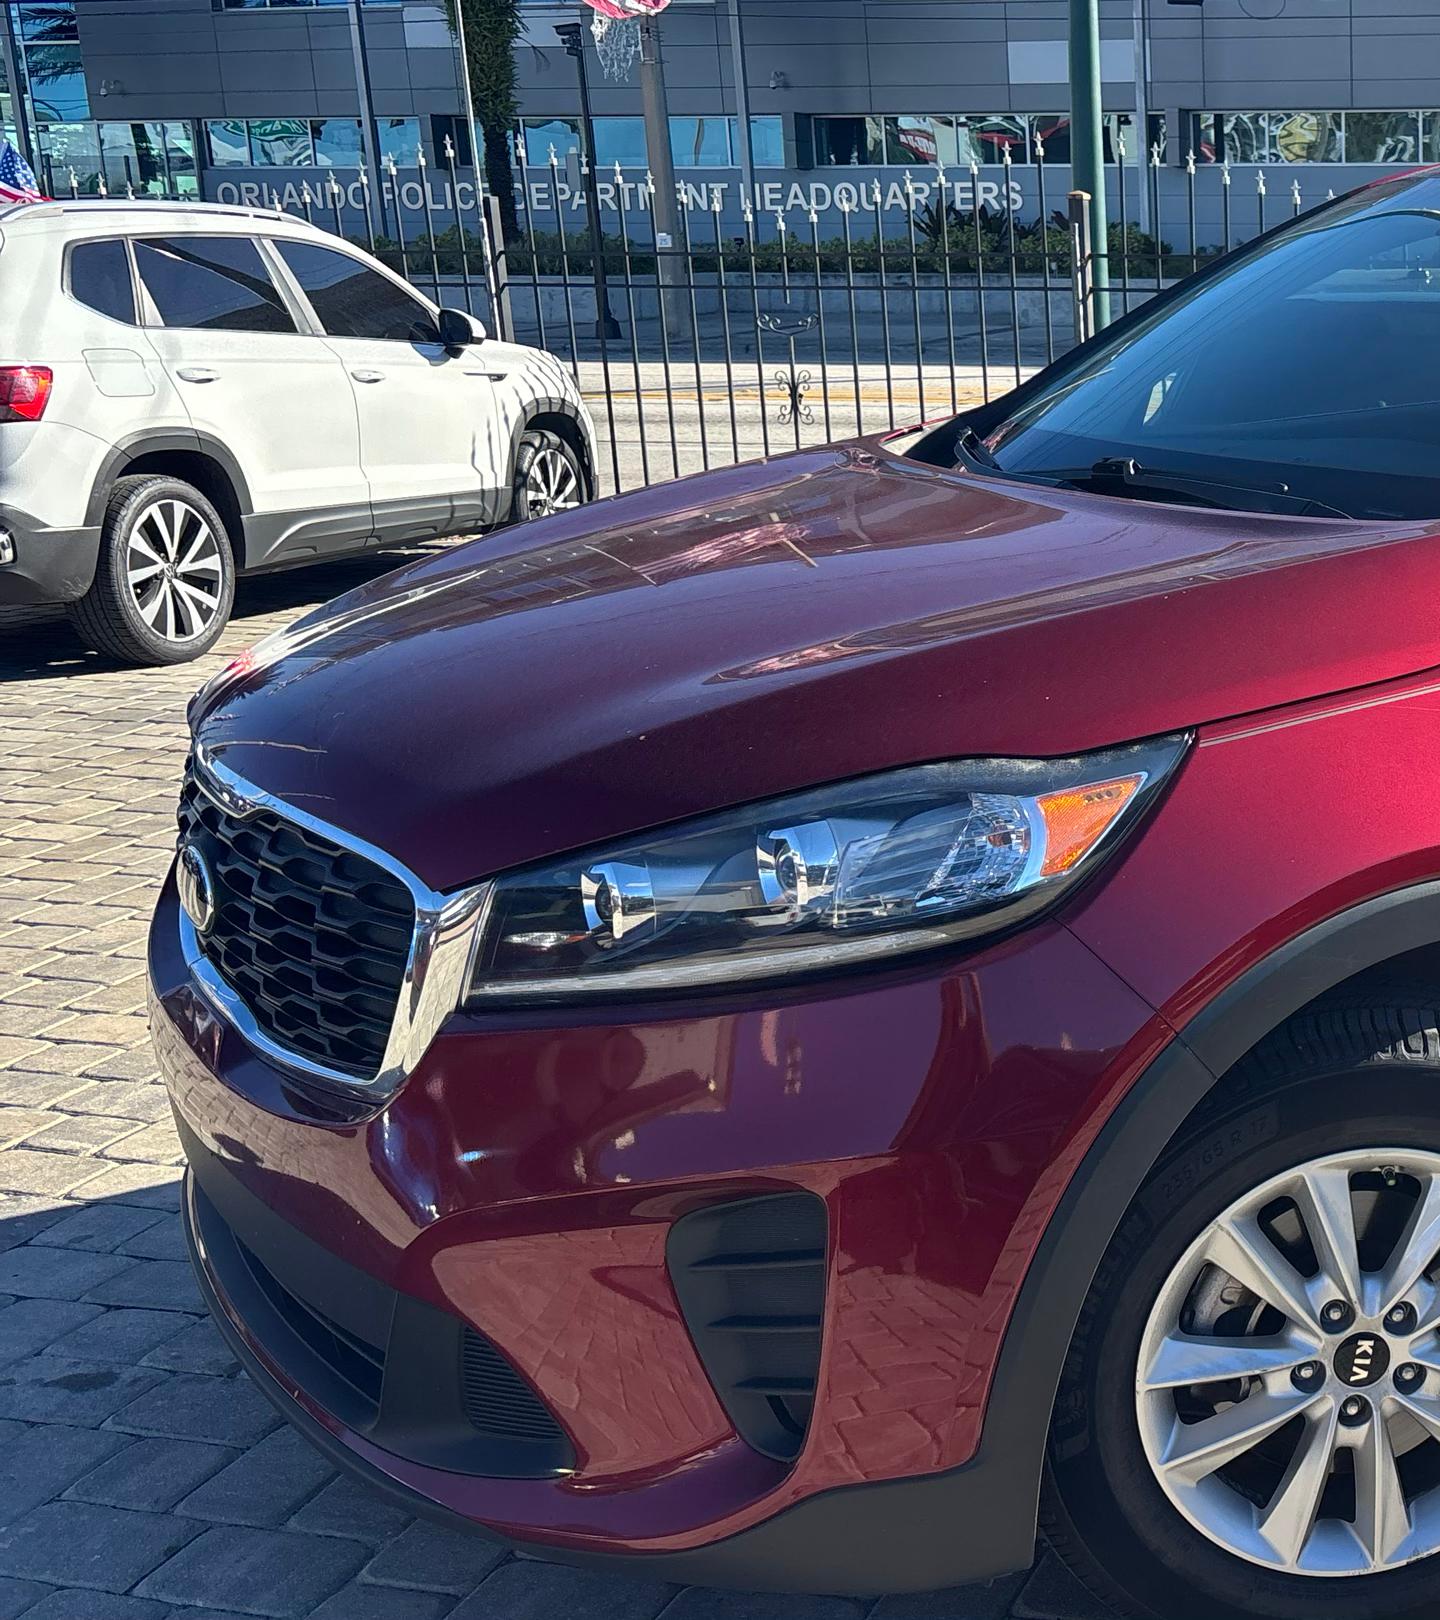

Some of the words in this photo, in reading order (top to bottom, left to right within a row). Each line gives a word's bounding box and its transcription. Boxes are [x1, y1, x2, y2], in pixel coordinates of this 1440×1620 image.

[217, 182, 370, 209] ORLANDO
[739, 182, 1023, 212] HEADQUARTERS
[1350, 1339, 1374, 1382] KIA
